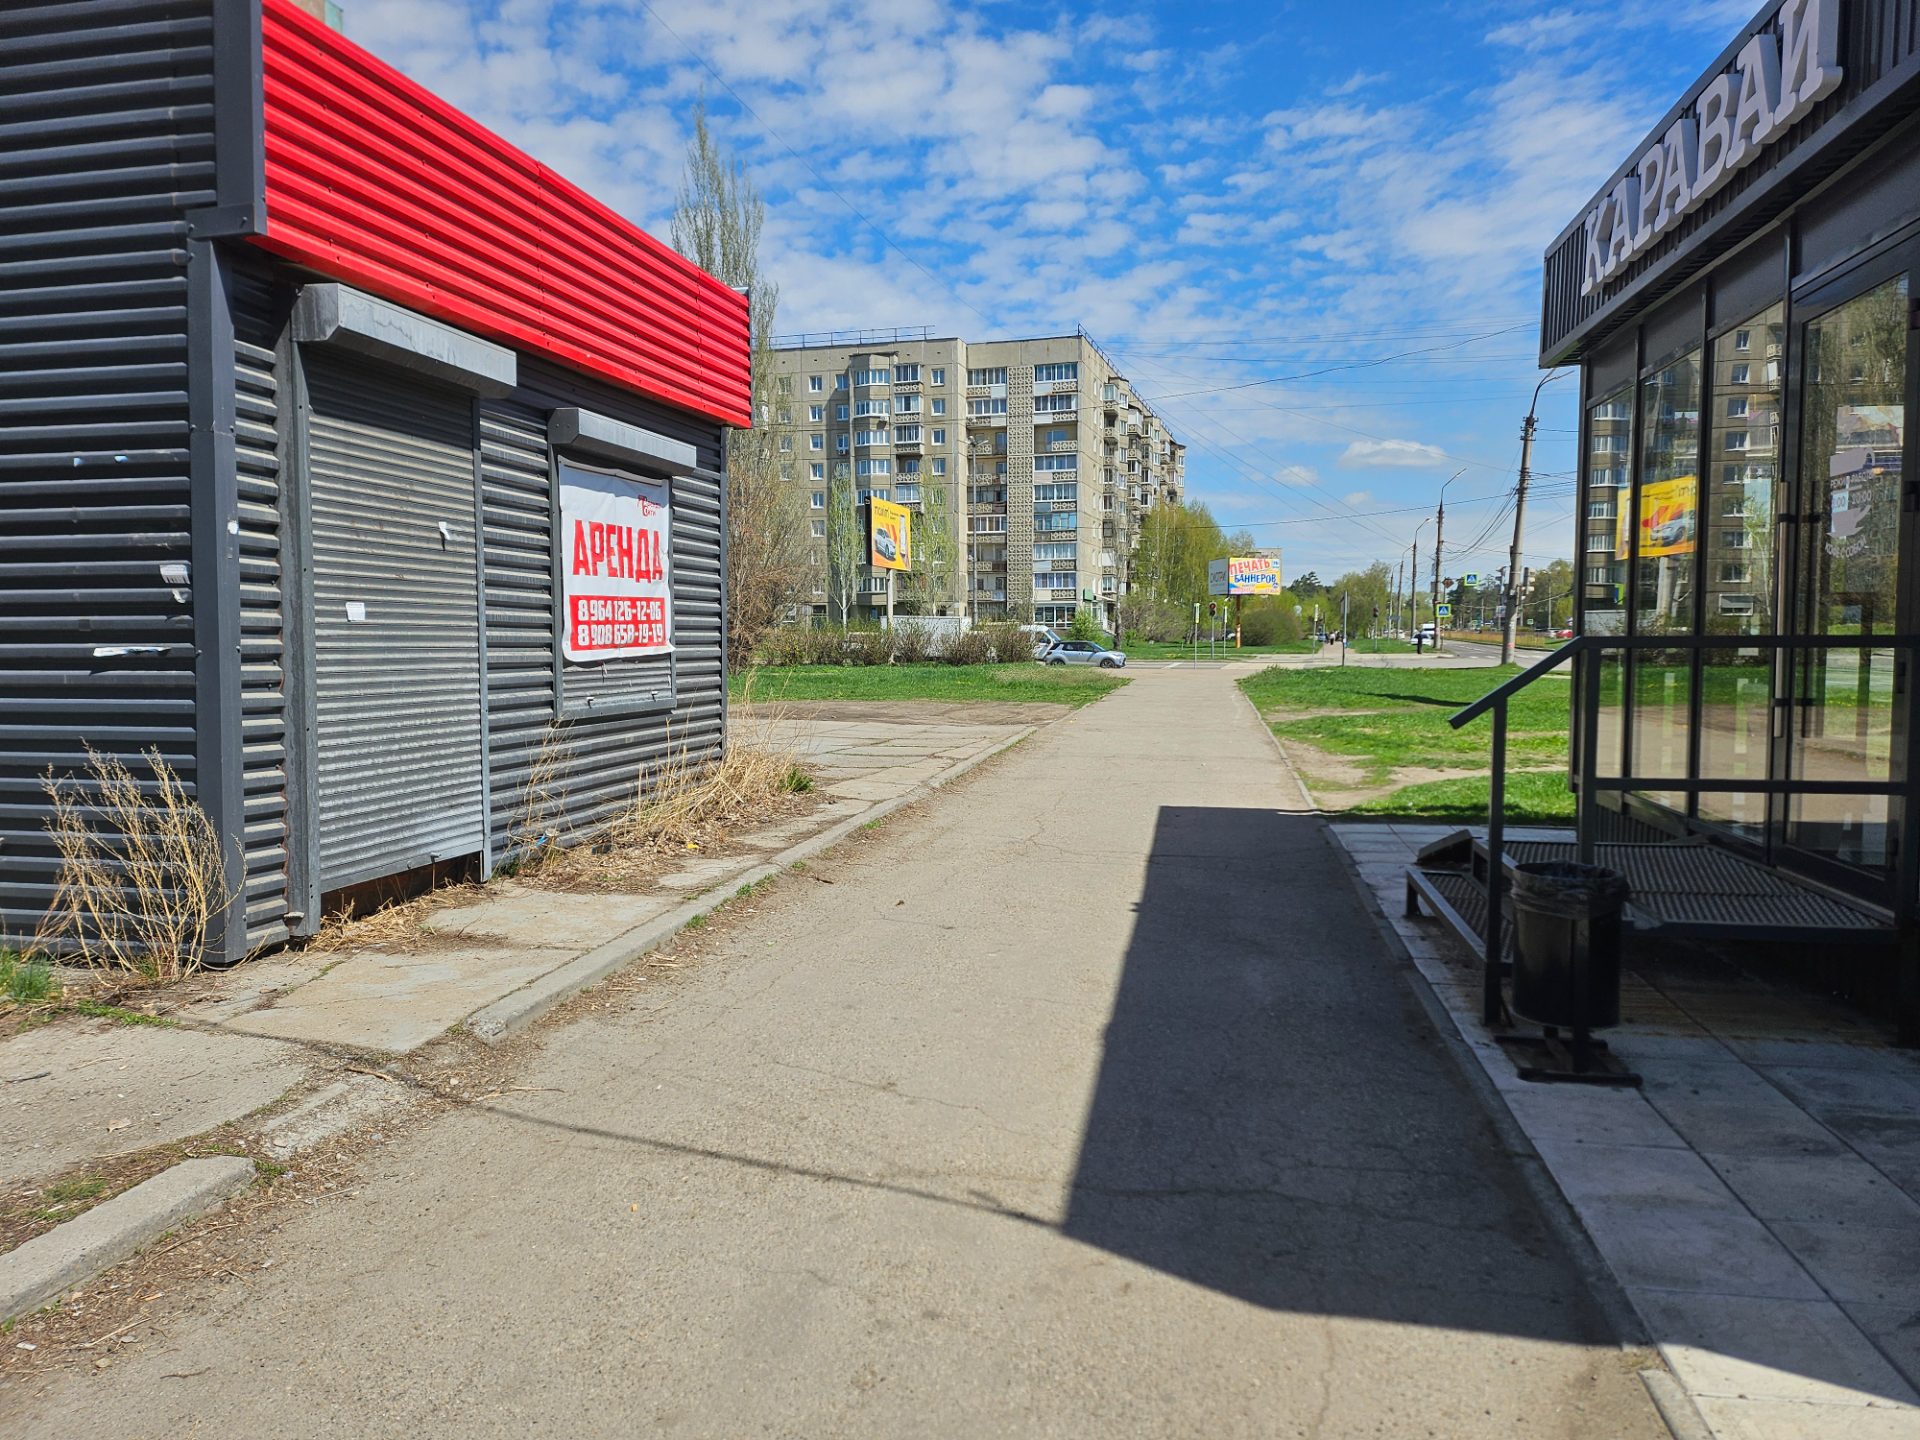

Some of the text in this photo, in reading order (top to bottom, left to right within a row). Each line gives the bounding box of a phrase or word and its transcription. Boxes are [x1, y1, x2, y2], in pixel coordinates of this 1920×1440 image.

[572, 519, 663, 583] АРЕНДА
[1229, 557, 1270, 575] ПЕЧАТЬ
[1234, 573, 1277, 584] БАННЕРОВ
[578, 599, 589, 621] 8
[589, 599, 613, 621] 964
[578, 624, 589, 646] 8
[590, 624, 613, 646] 908
